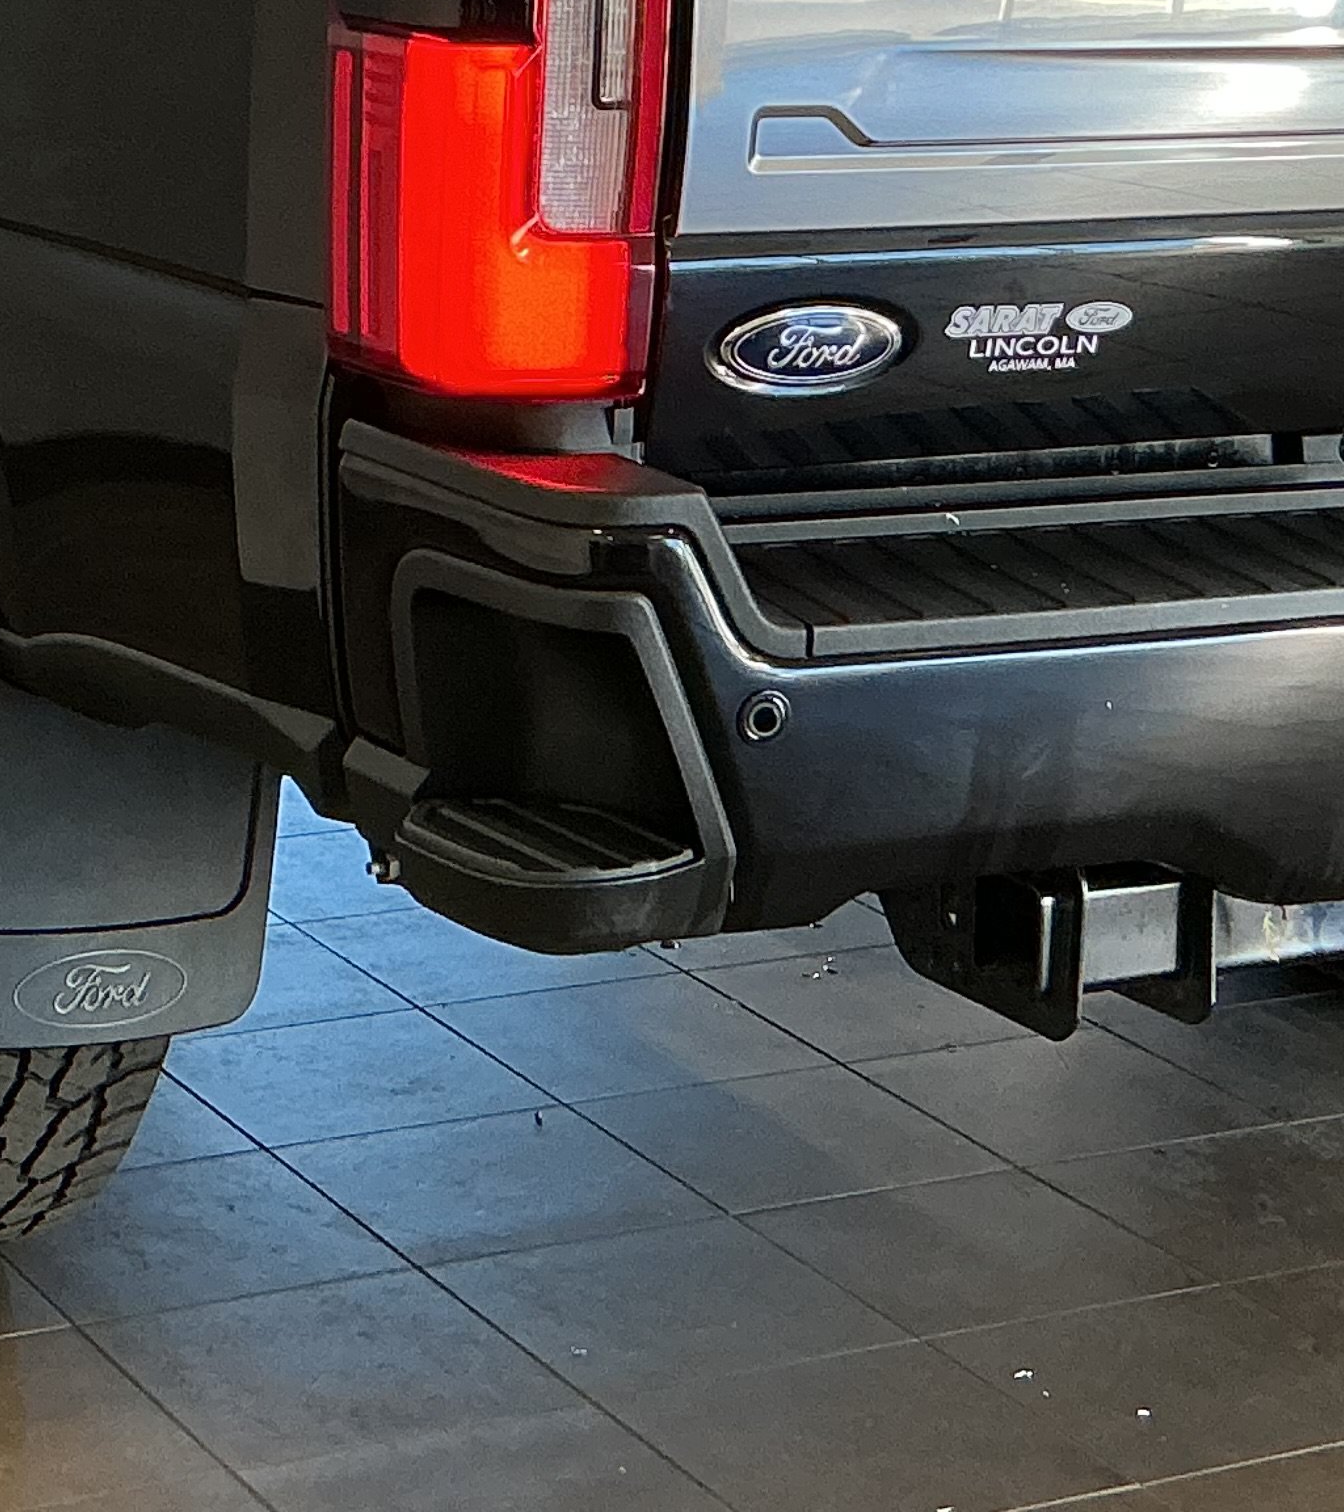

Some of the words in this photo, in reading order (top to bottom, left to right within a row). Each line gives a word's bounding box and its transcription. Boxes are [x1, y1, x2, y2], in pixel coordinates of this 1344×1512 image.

[946, 303, 1064, 337] SARAT
[767, 323, 863, 369] Ford
[969, 335, 1098, 359] LINCOLN
[988, 358, 1052, 373] AGAWAM,
[1055, 356, 1076, 370] MA
[53, 963, 152, 1015] Ford
